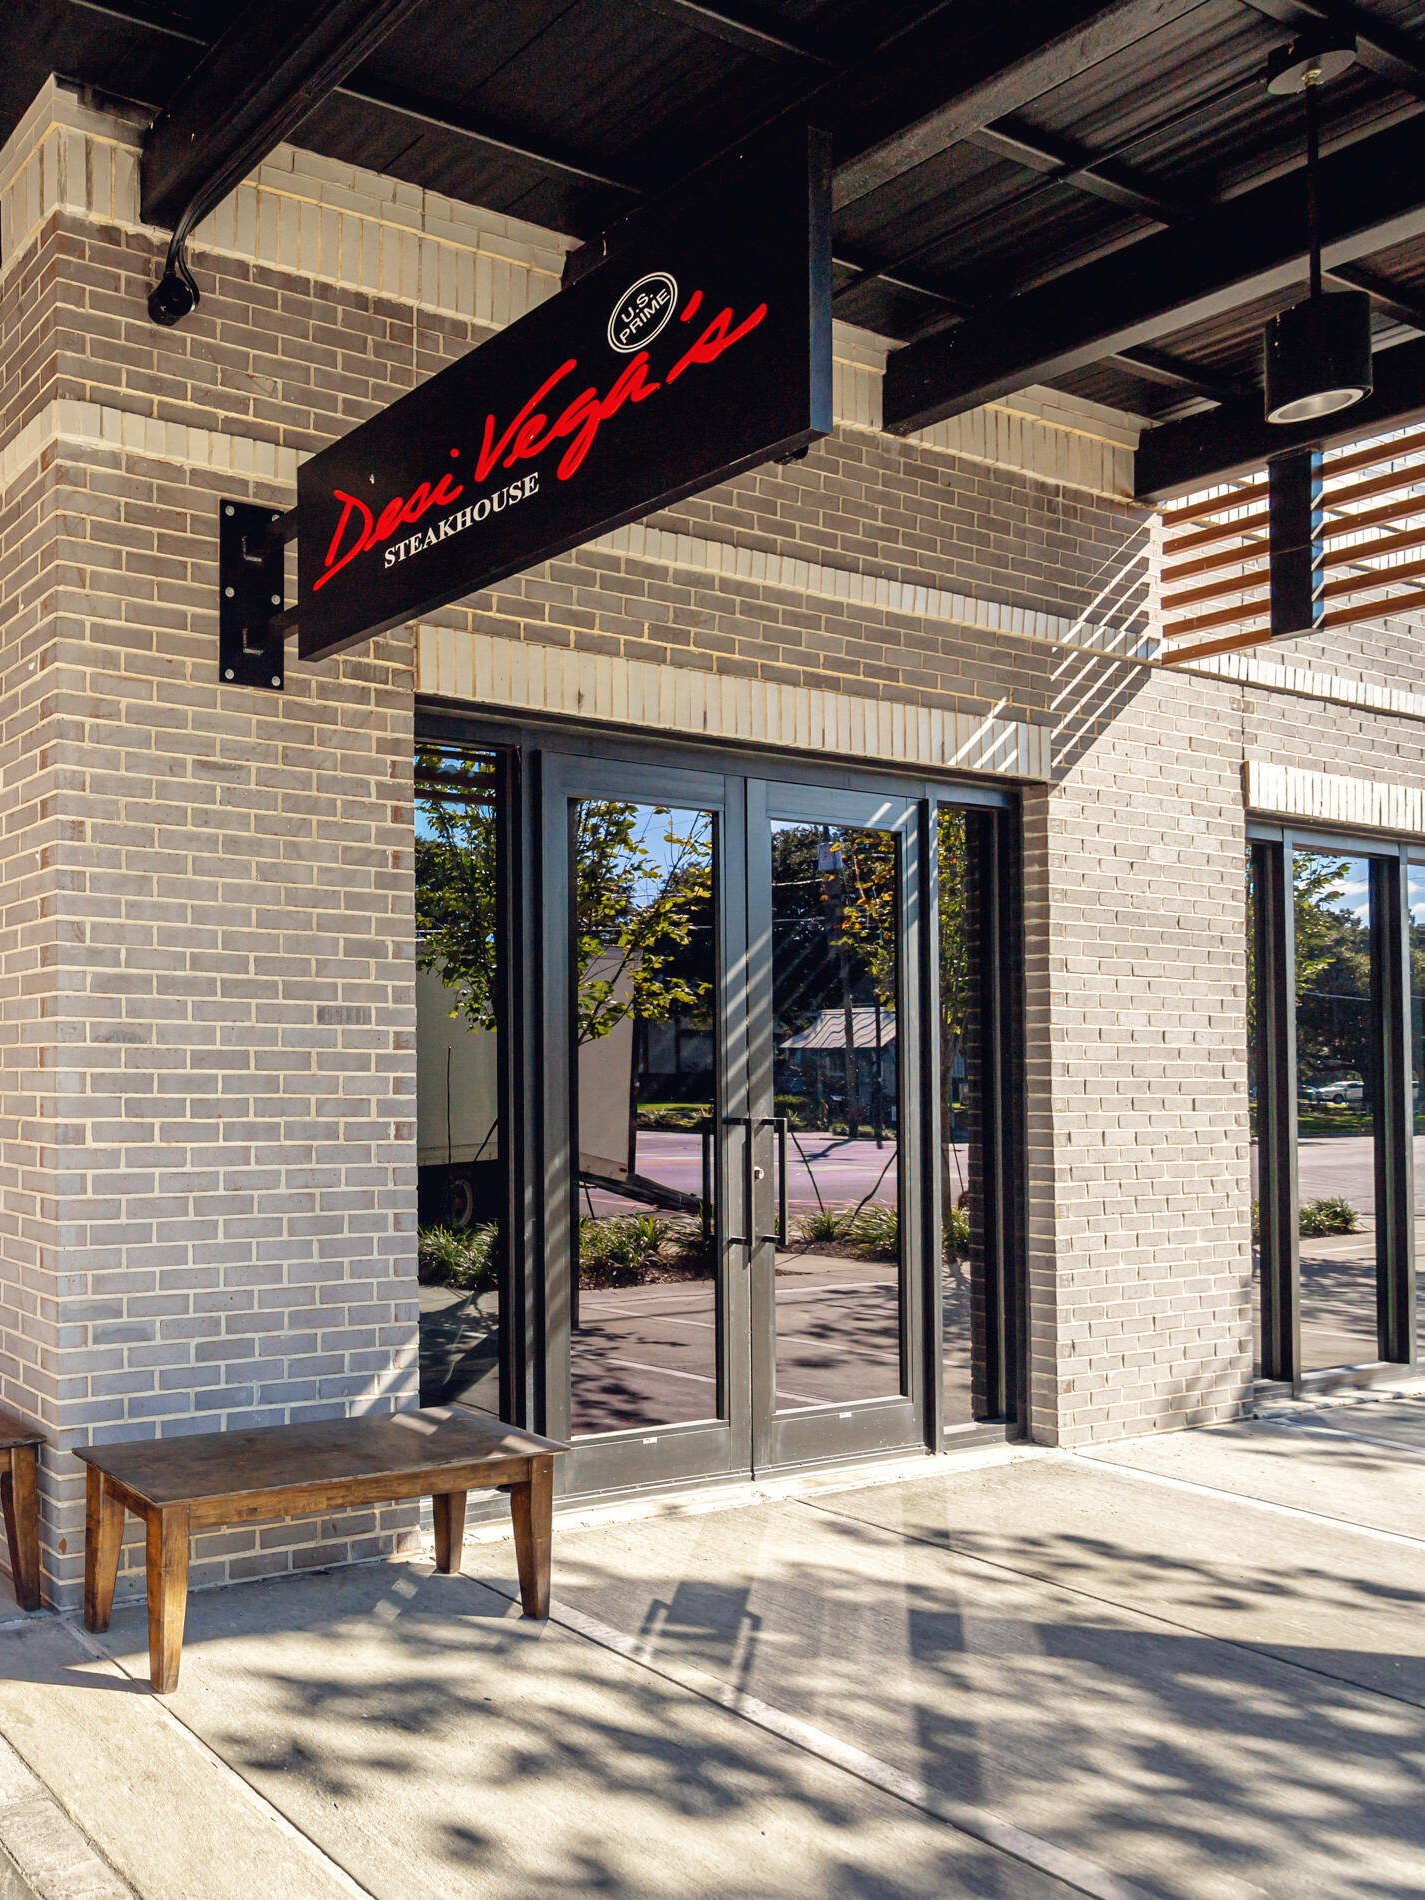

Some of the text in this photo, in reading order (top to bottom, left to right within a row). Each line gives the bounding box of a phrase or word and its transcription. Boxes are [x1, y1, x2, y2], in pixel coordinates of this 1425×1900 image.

[619, 288, 671, 344] PRIME
[621, 293, 654, 323] U.S.
[312, 290, 768, 592] Desi Vega's
[383, 471, 541, 570] STEAKHOUSE
